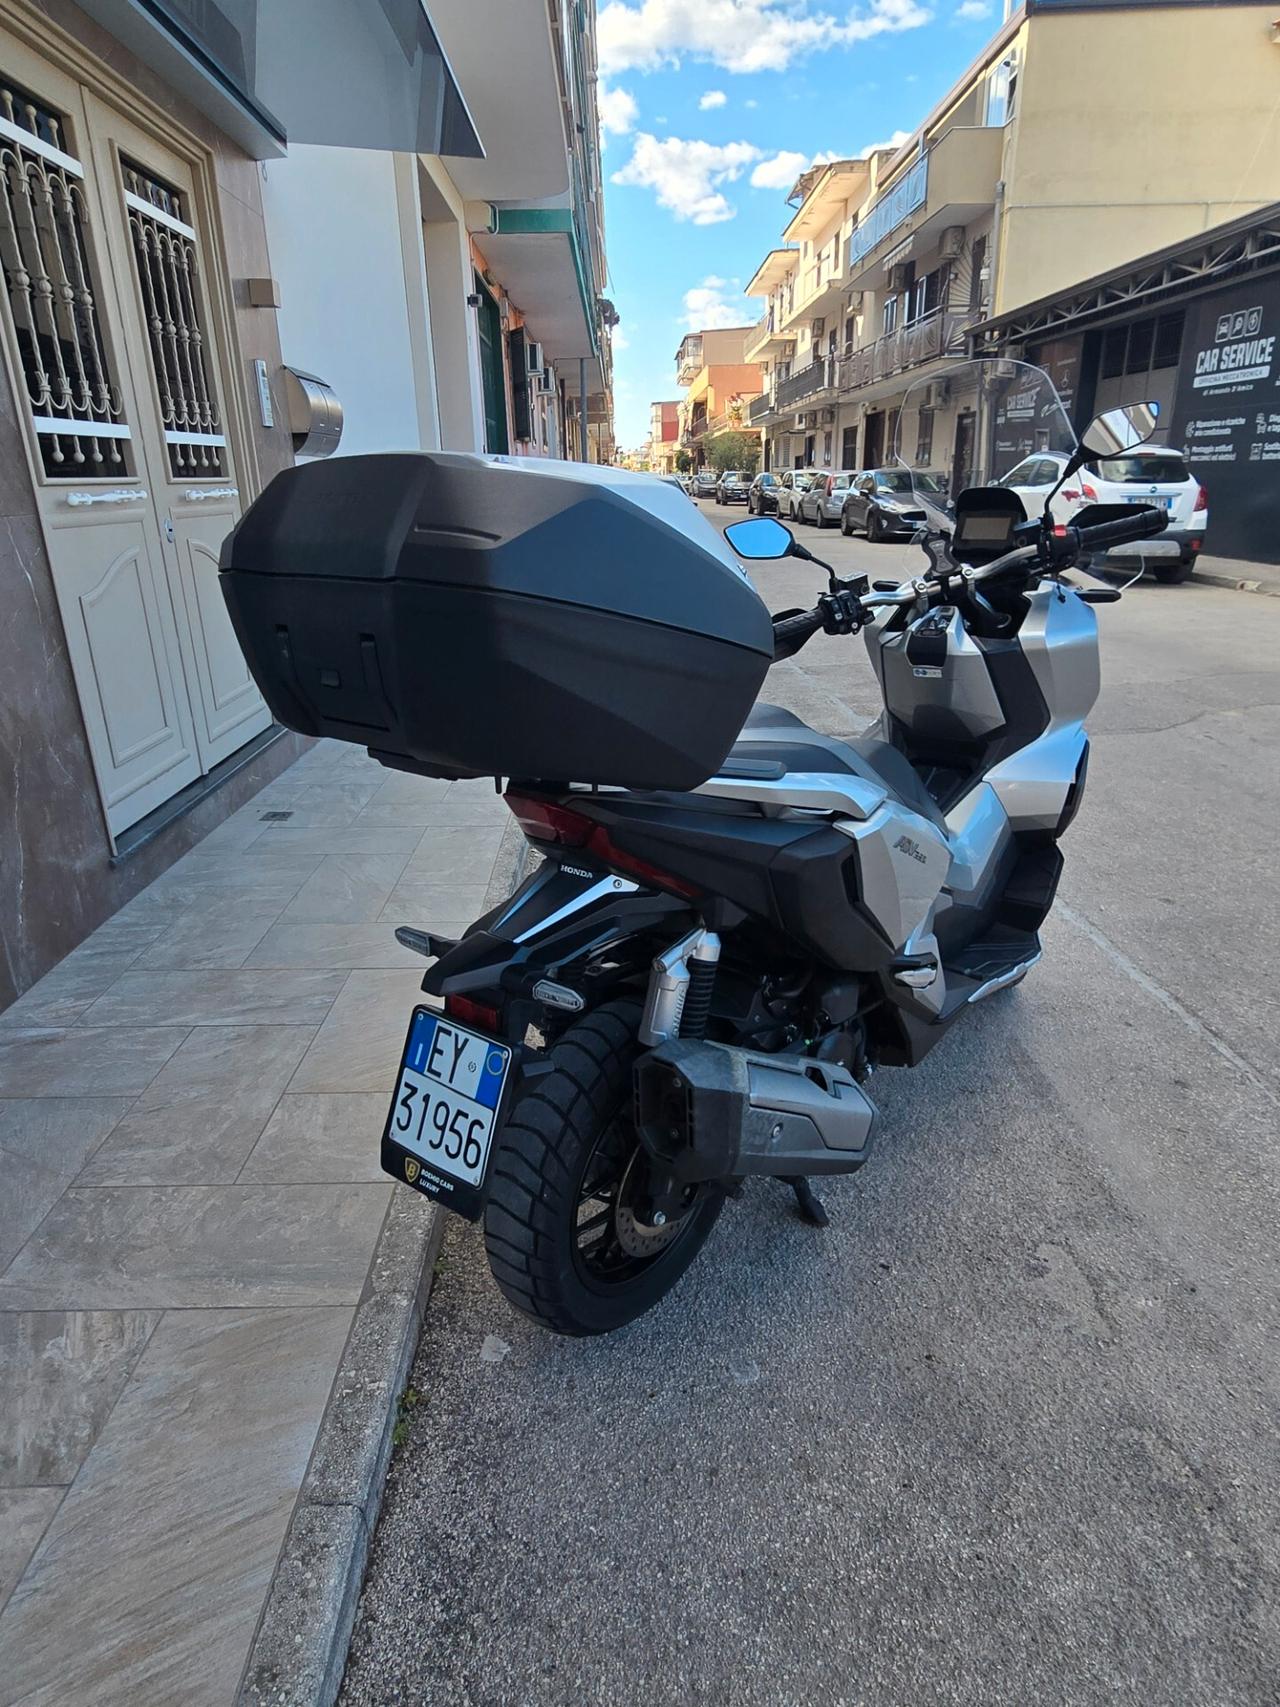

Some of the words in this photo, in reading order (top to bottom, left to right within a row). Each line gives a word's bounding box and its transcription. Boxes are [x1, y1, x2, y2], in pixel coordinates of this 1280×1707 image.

[1195, 348, 1219, 374] CAR
[1220, 336, 1275, 369] SERVICE
[560, 864, 593, 879] HONDA
[427, 1025, 470, 1084] EY
[396, 1081, 485, 1169] 31956
[419, 1178, 440, 1193] LUXURY
[440, 1179, 455, 1192] CARS
